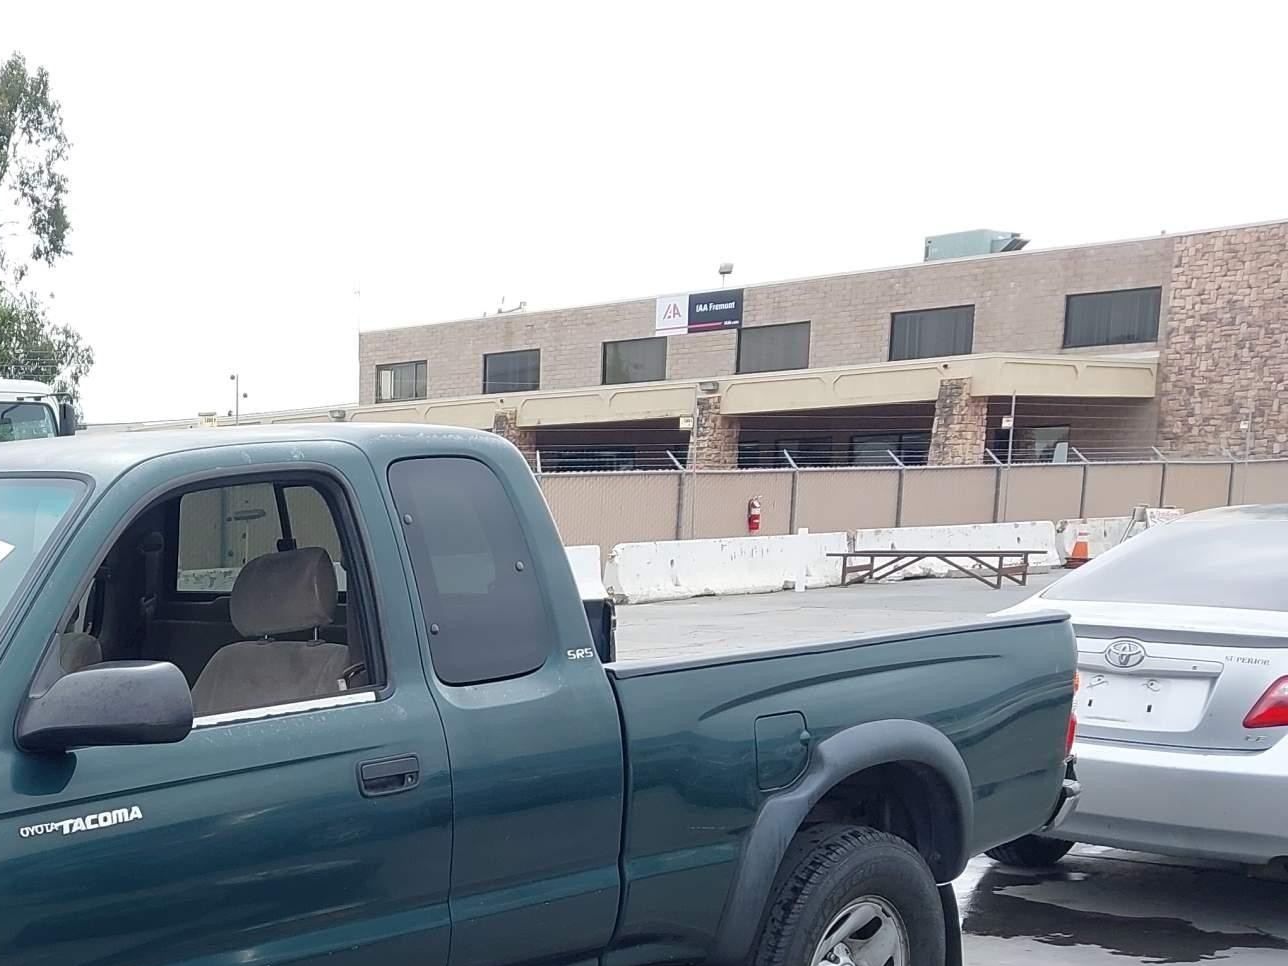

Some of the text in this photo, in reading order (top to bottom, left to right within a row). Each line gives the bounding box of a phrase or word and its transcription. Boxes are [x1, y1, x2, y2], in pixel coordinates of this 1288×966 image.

[696, 301, 736, 313] IAA Fremont
[58, 805, 143, 835] TACOMA
